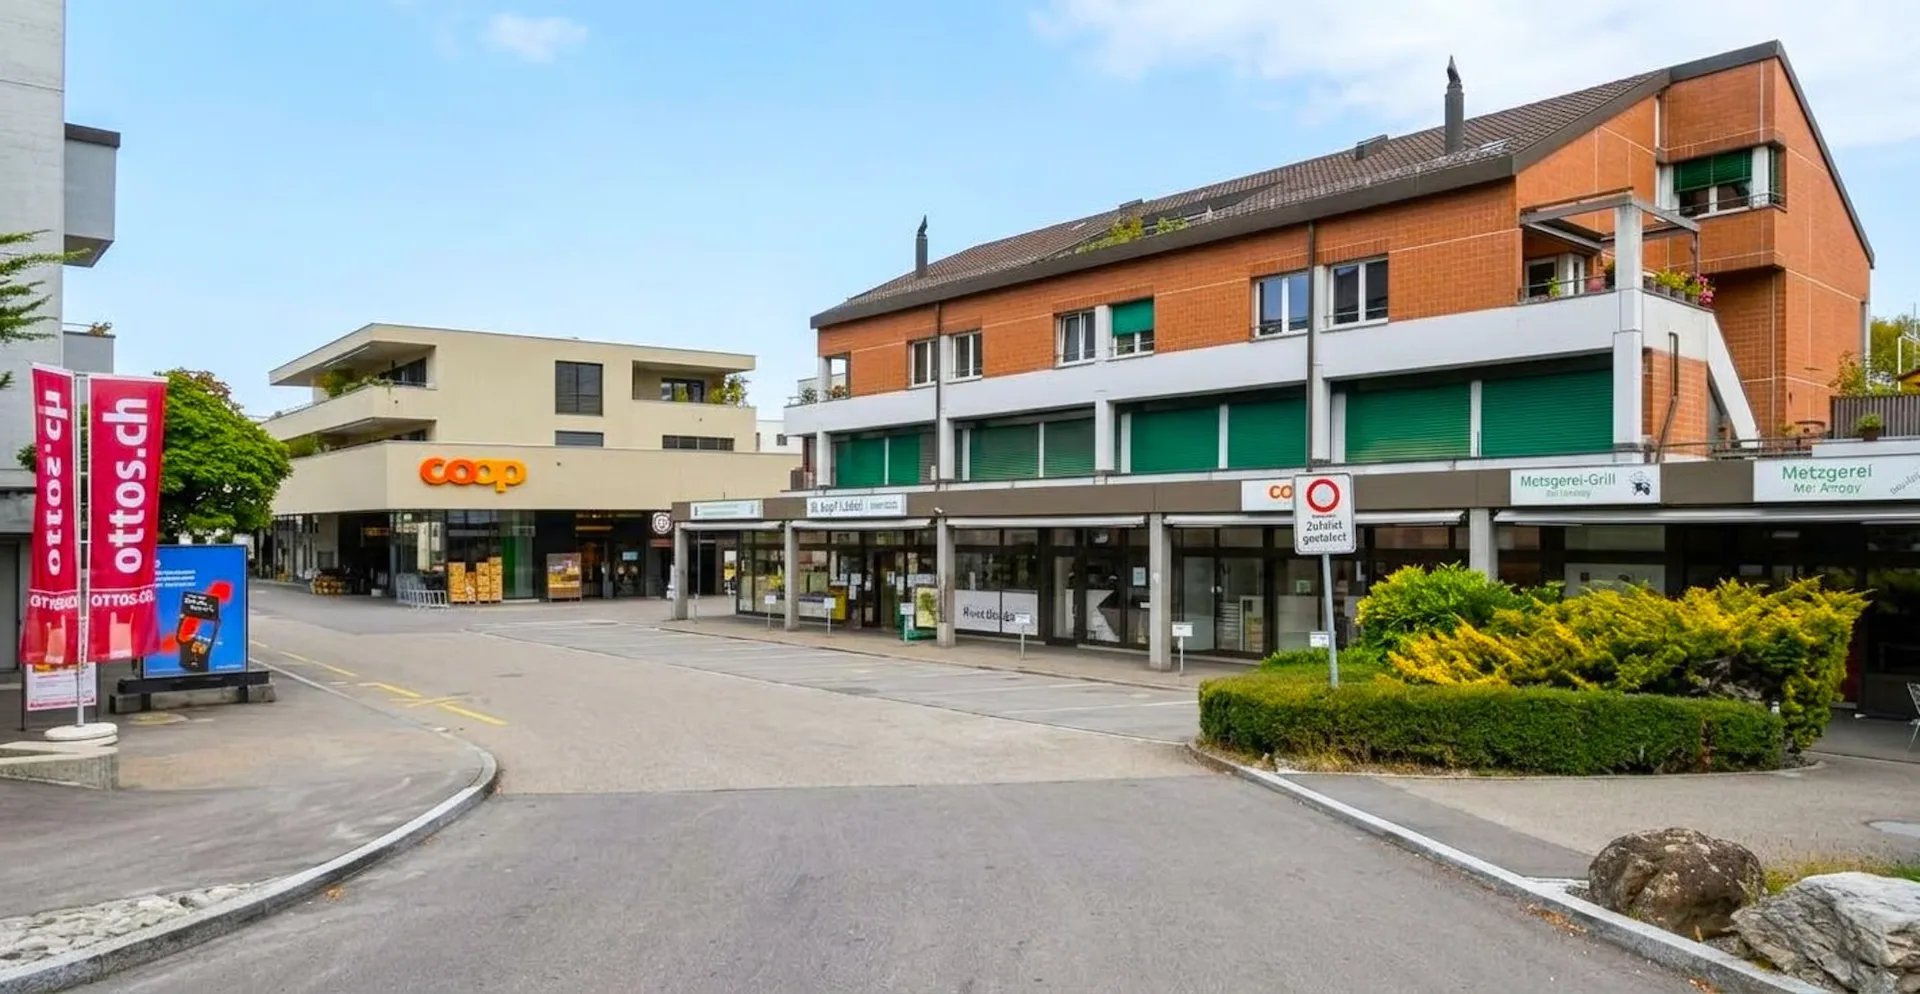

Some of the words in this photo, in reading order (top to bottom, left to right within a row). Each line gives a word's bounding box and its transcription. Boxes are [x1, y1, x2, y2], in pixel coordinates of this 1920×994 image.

[102, 398, 148, 574] ottos.ch
[420, 457, 526, 493] coop
[1782, 464, 1872, 482] Metzgerei
